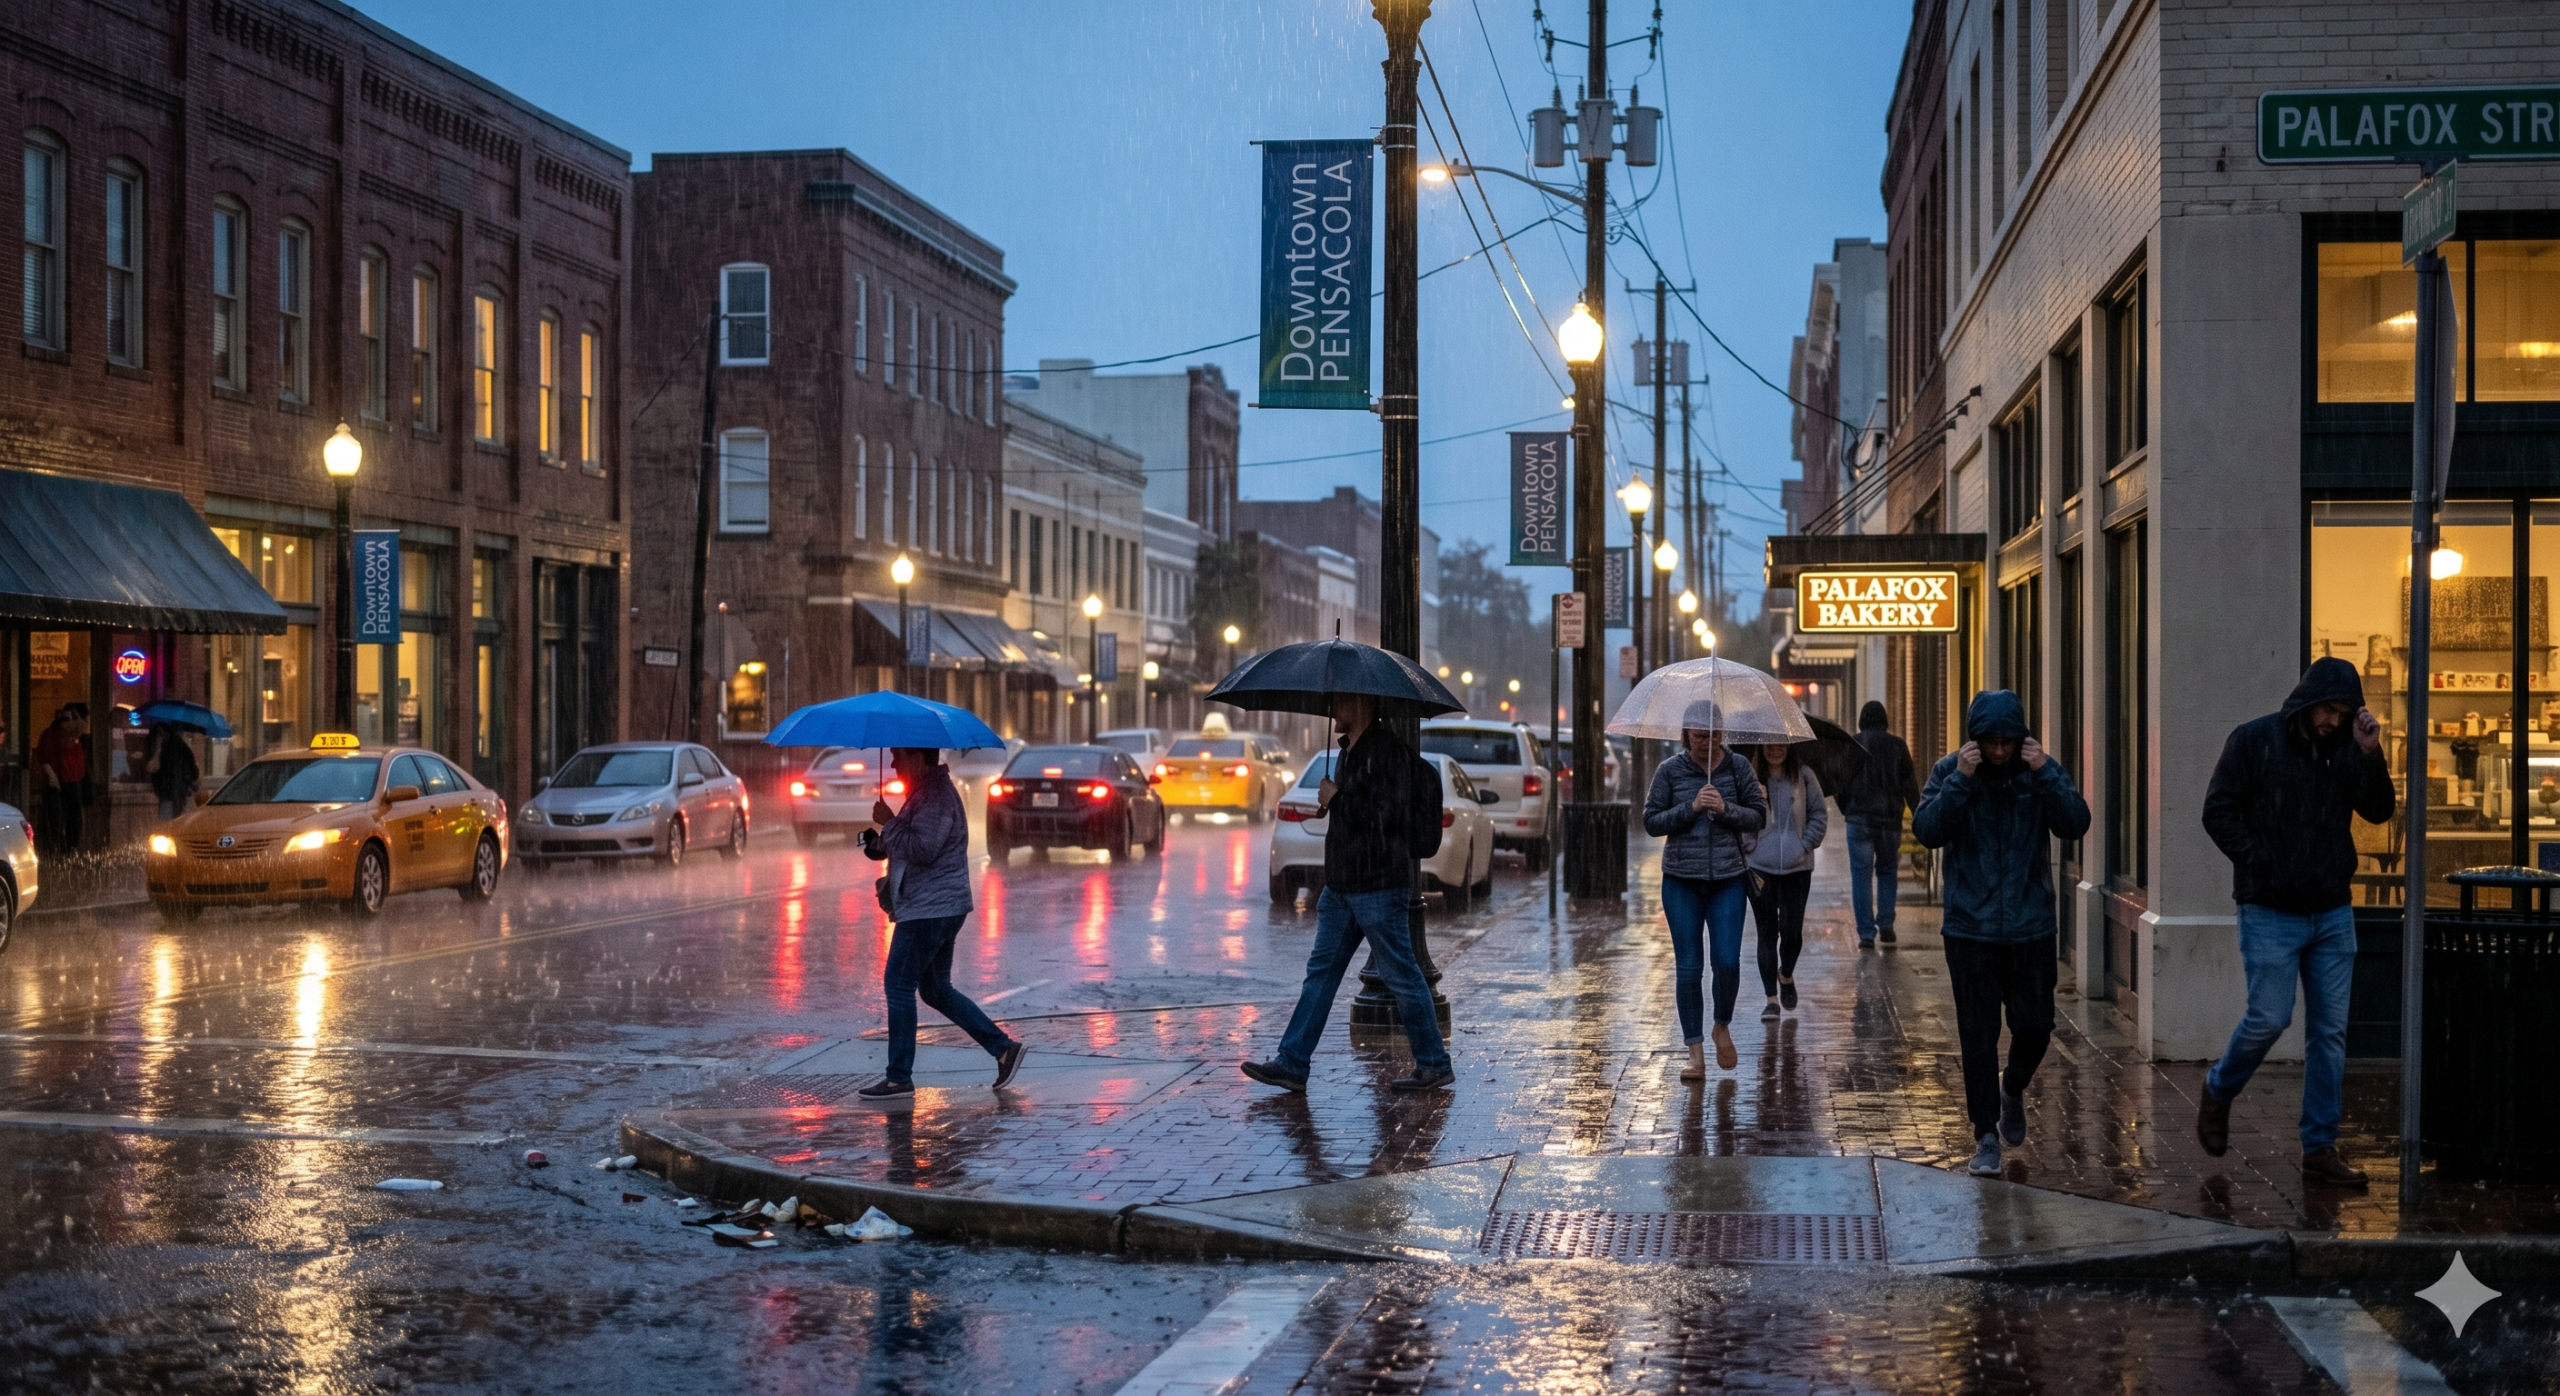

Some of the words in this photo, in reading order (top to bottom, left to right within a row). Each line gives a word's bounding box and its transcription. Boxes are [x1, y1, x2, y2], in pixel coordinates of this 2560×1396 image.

[2278, 103, 2458, 147] PALAFOX
[2480, 101, 2560, 143] STR
[1280, 163, 1317, 381] Downtown
[1319, 159, 1353, 381] PENSACOLA
[1520, 442, 1539, 552] Downtown
[1540, 440, 1557, 553] PENSACOLA
[362, 540, 377, 634] Downtown
[377, 540, 391, 634] PENSACOLA
[1808, 577, 1949, 602] PALAFOX
[1817, 602, 1939, 627] BAKERY
[116, 656, 146, 676] OPEN
